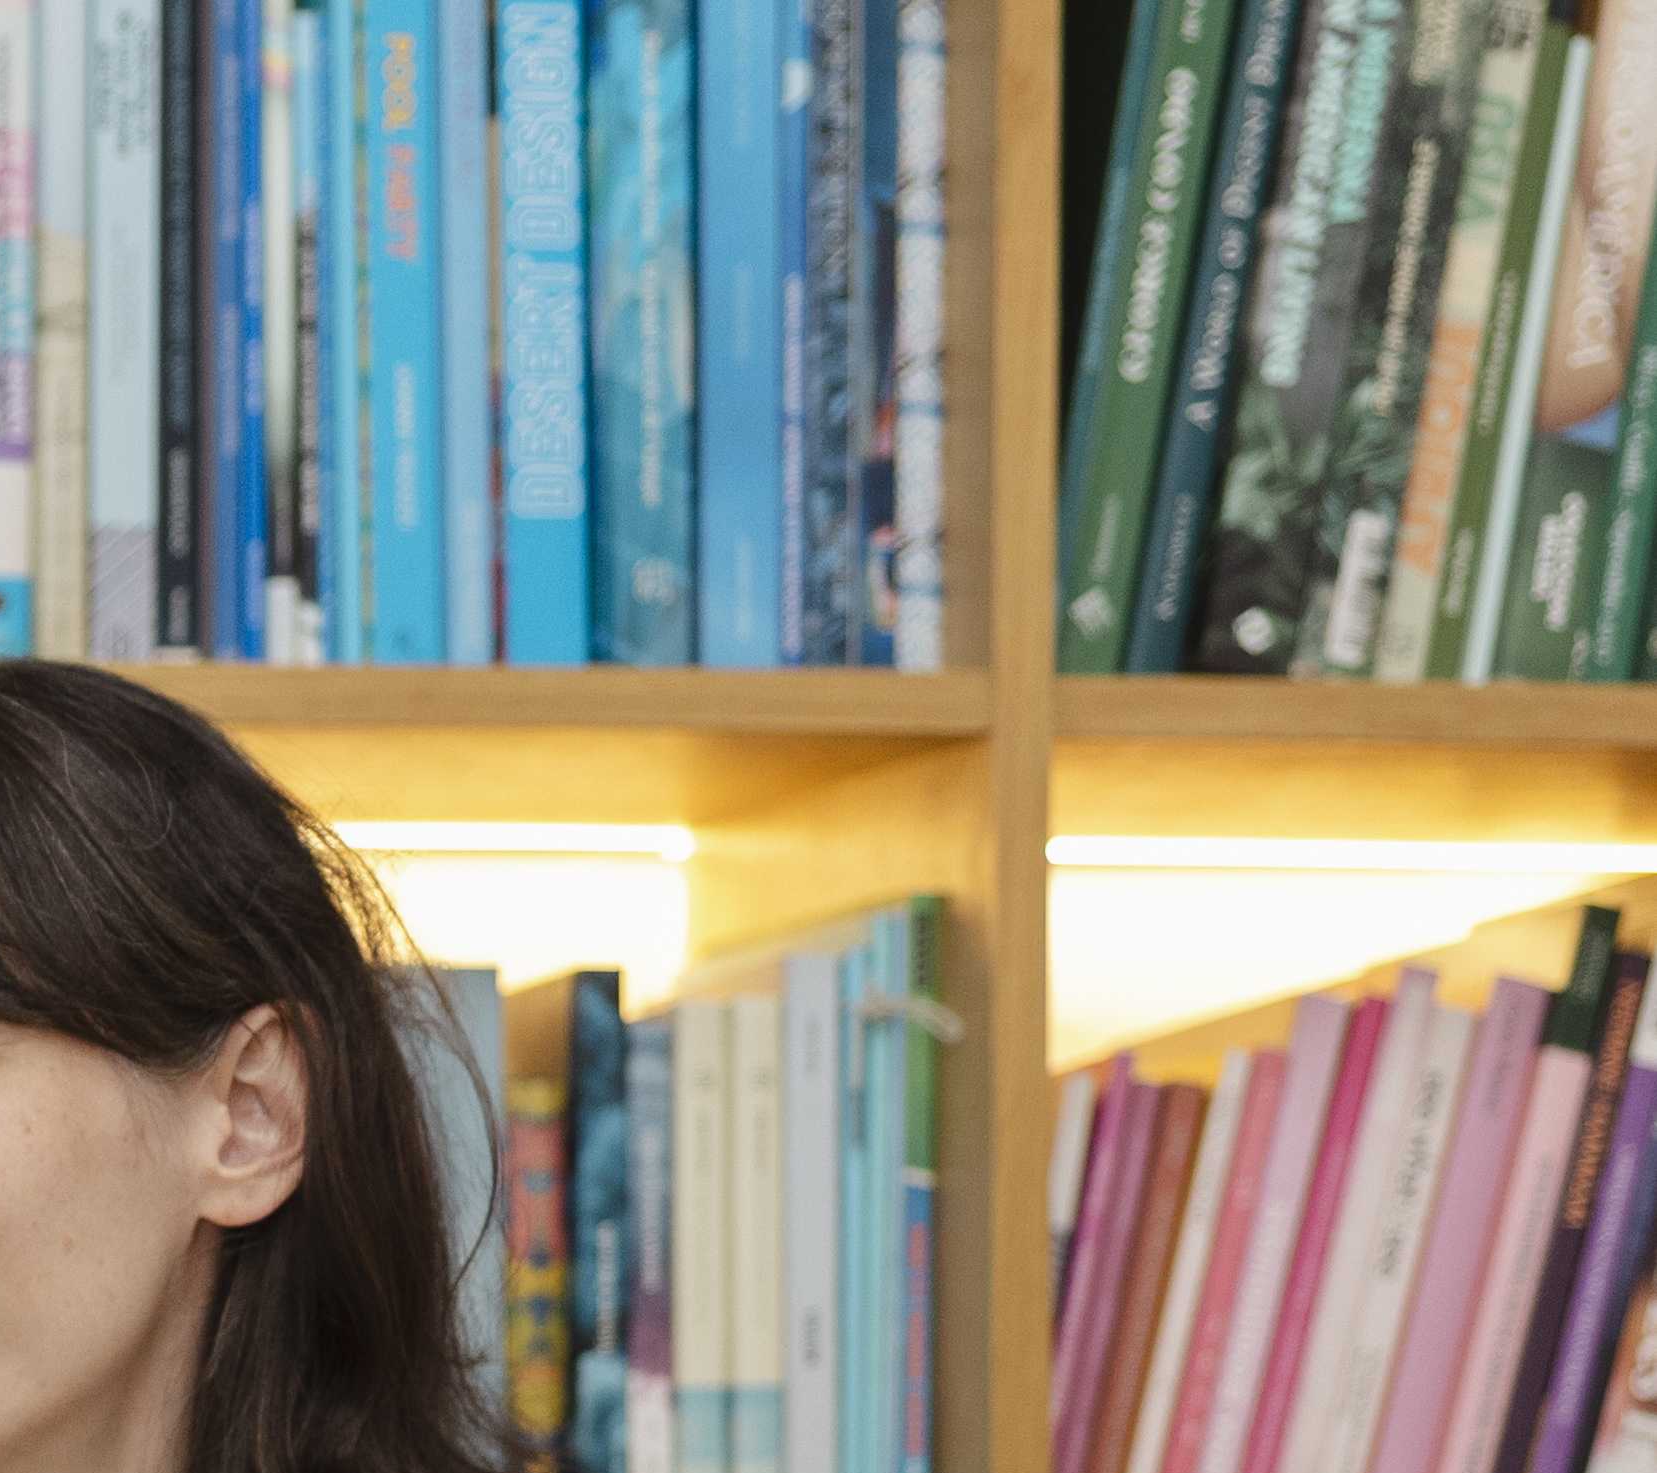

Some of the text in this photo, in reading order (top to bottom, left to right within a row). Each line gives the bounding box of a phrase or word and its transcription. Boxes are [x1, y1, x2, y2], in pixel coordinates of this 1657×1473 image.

[382, 32, 420, 263] POOL PARTY
[502, 0, 586, 520] DESERT DESIGN
